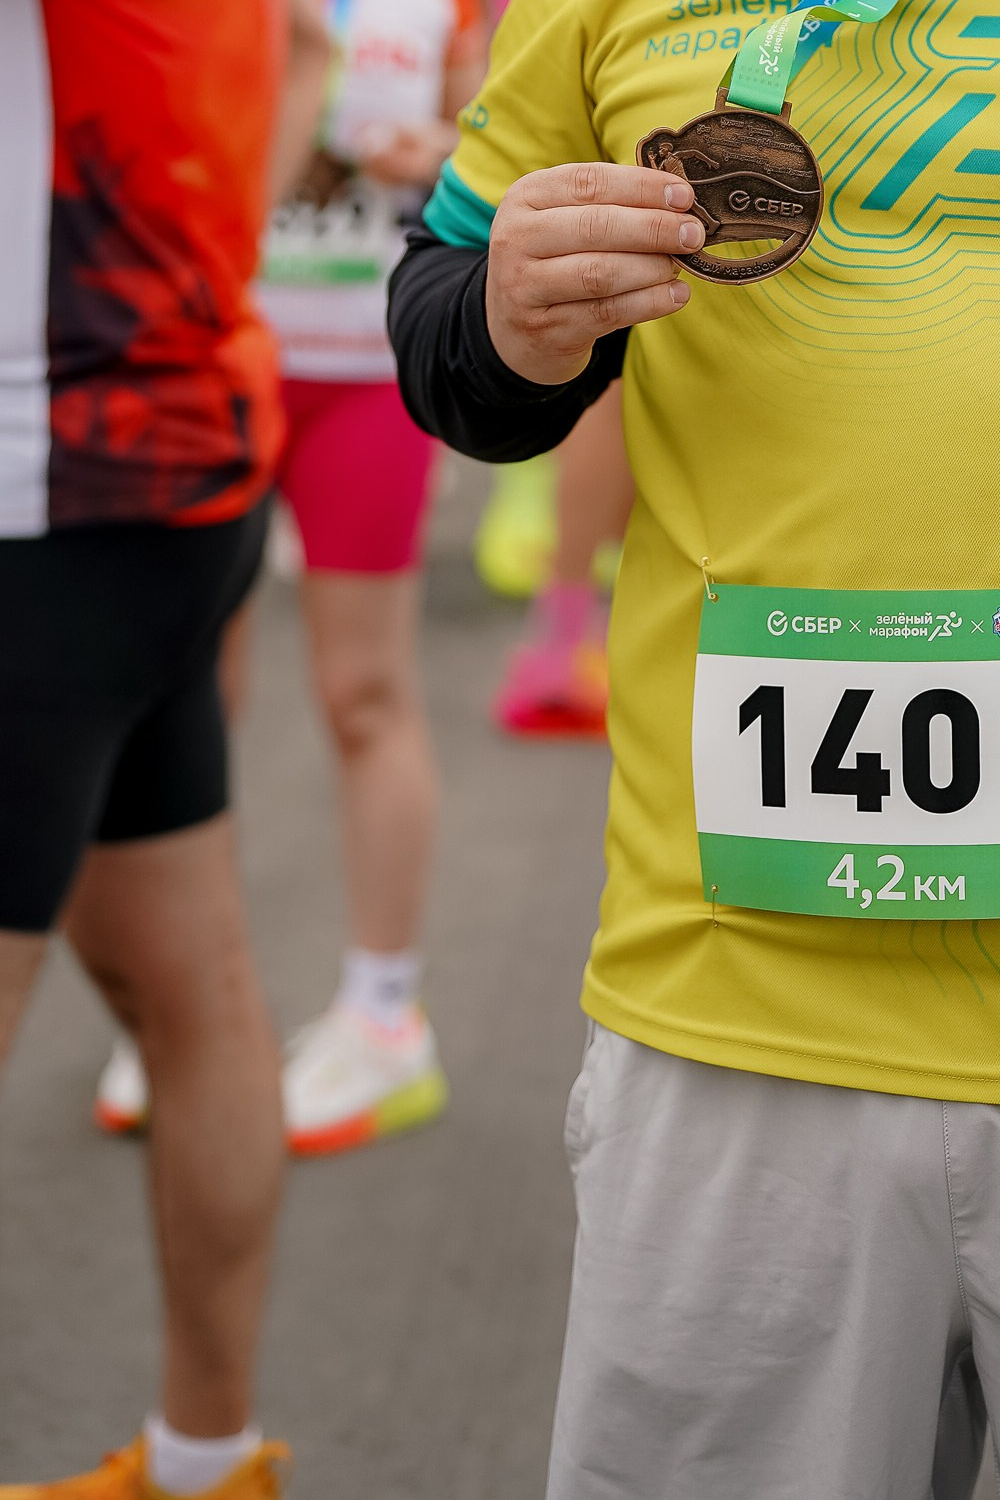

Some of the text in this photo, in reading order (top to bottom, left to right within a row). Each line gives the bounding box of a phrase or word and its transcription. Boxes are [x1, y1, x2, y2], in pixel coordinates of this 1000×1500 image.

[754, 197, 803, 217] СБЕР
[724, 260, 777, 278] марафон
[791, 616, 842, 634] СБЕР
[876, 611, 933, 625] зелёный
[869, 625, 928, 639] марафон
[826, 853, 966, 910] 4,2 км
